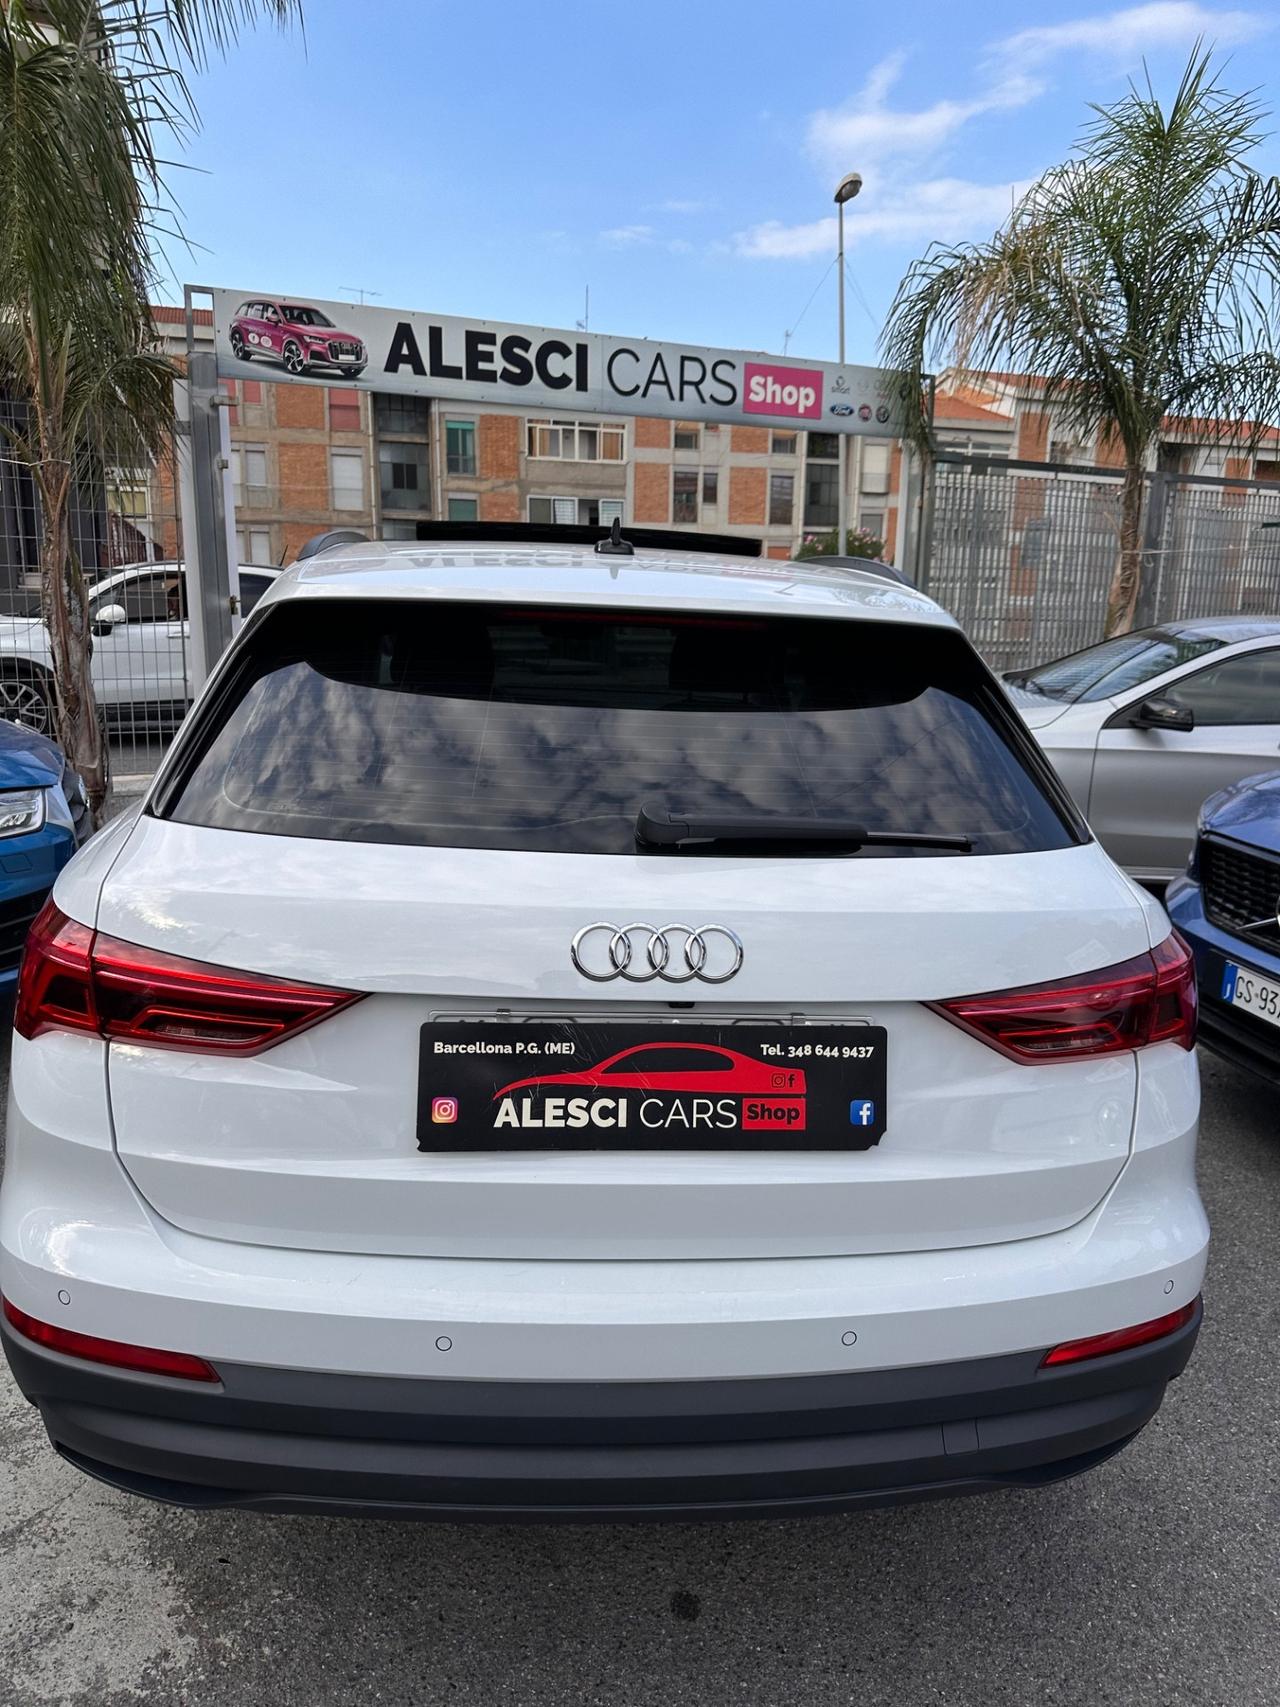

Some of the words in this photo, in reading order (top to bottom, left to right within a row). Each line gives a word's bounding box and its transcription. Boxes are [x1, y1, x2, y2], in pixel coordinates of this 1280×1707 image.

[383, 321, 589, 393] ALESCI
[606, 347, 738, 406] CARS
[748, 374, 816, 414] Shop
[1258, 986, 1280, 1019] 93
[433, 1041, 513, 1054] Barcellona
[515, 1042, 542, 1054] P.G.
[544, 1041, 576, 1055] (ME)
[760, 1043, 785, 1056] Tel.
[787, 1044, 812, 1058] 348
[814, 1044, 840, 1058] 644
[841, 1046, 875, 1058] 9437
[493, 1097, 628, 1128] ALESCI
[639, 1098, 738, 1129] CARS
[746, 1103, 800, 1125] Shop
